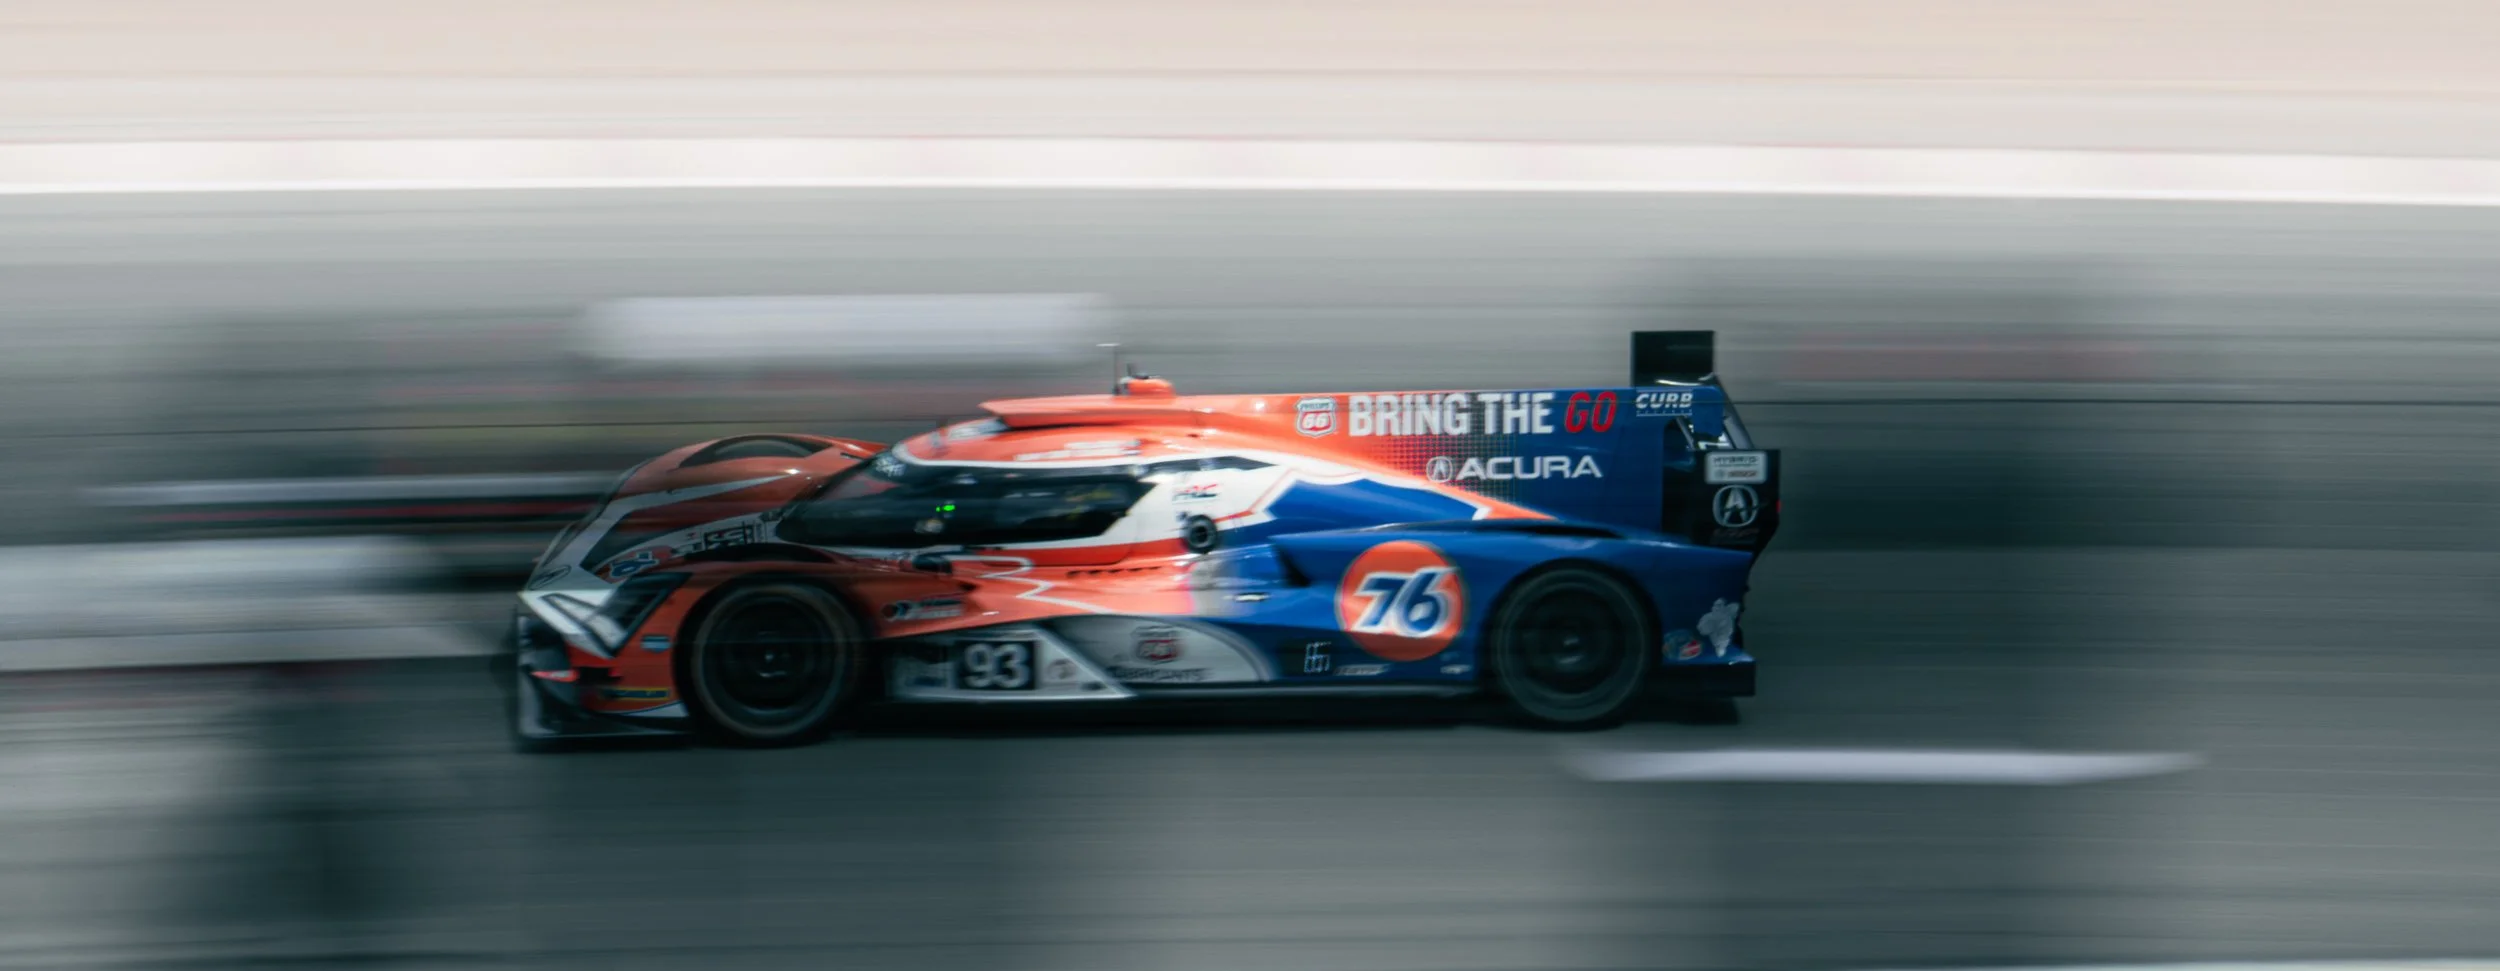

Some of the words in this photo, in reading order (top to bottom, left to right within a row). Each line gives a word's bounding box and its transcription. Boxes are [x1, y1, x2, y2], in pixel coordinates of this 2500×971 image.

[1348, 393, 1471, 436] BRING
[1478, 392, 1555, 434] THE
[1564, 391, 1617, 433] GO
[1635, 393, 1693, 409] CURB
[1302, 413, 1330, 429] 66
[1456, 455, 1603, 480] ACURA
[1352, 566, 1460, 639] 76
[963, 642, 1030, 688] 93
